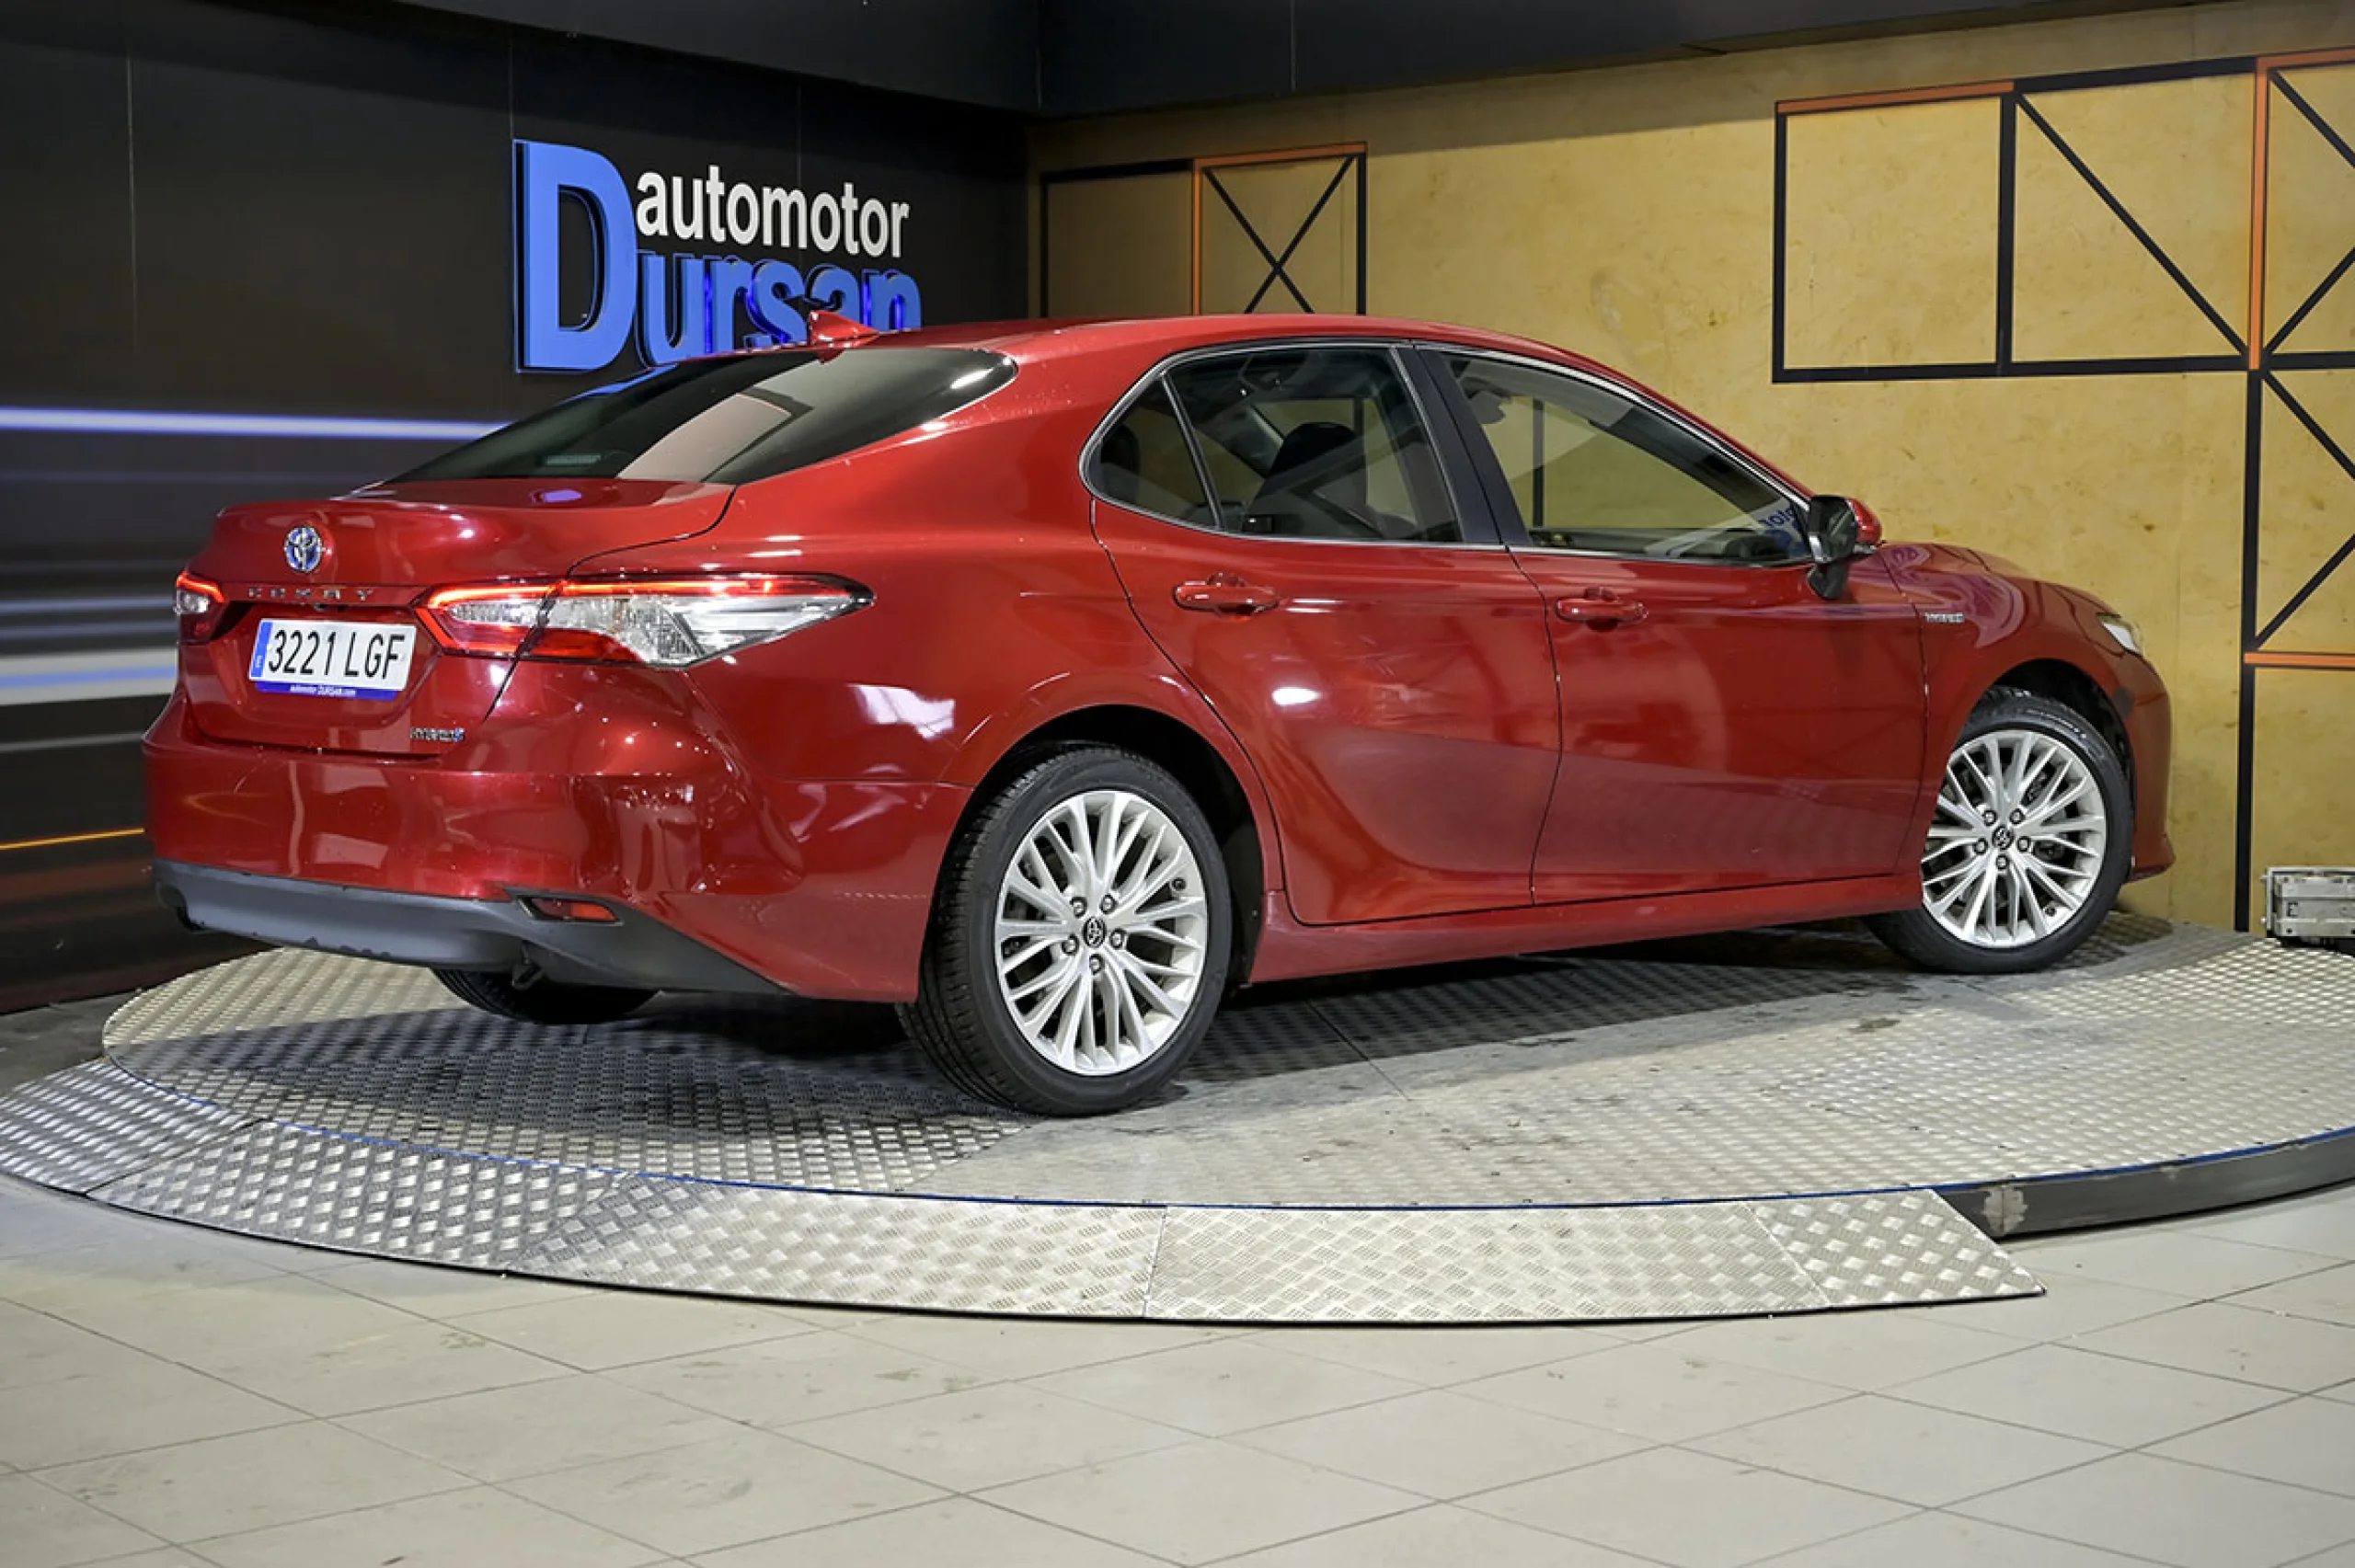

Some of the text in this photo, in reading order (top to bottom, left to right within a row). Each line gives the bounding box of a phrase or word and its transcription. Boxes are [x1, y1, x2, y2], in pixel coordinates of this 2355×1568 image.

[636, 165, 910, 258] automotor
[268, 629, 406, 680] 3221 LGF
